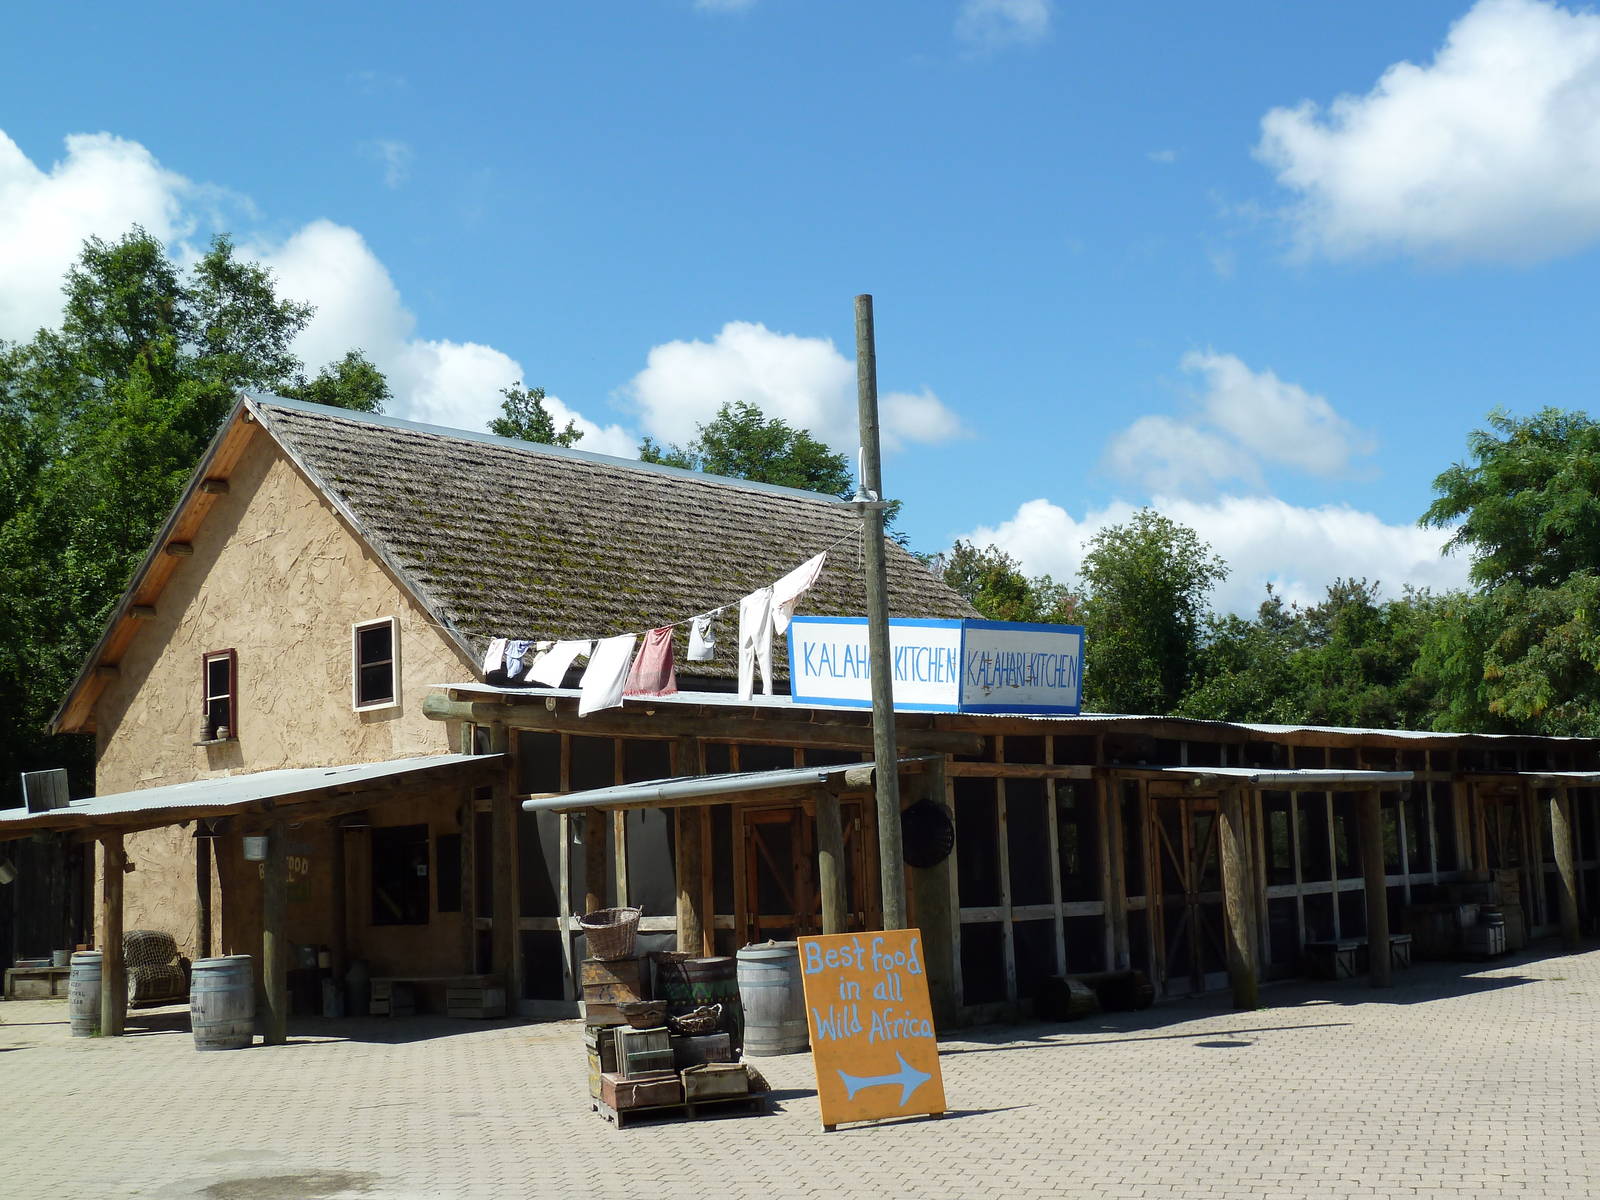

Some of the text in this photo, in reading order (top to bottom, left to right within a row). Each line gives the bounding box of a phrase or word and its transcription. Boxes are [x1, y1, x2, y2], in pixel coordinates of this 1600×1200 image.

[803, 641, 957, 684] KALAH KITCHEN
[967, 650, 1078, 689] KALAHARI KITCHEN
[804, 936, 923, 975] Best food
[839, 973, 904, 1002] in all
[811, 1003, 935, 1045] Wild Africa
